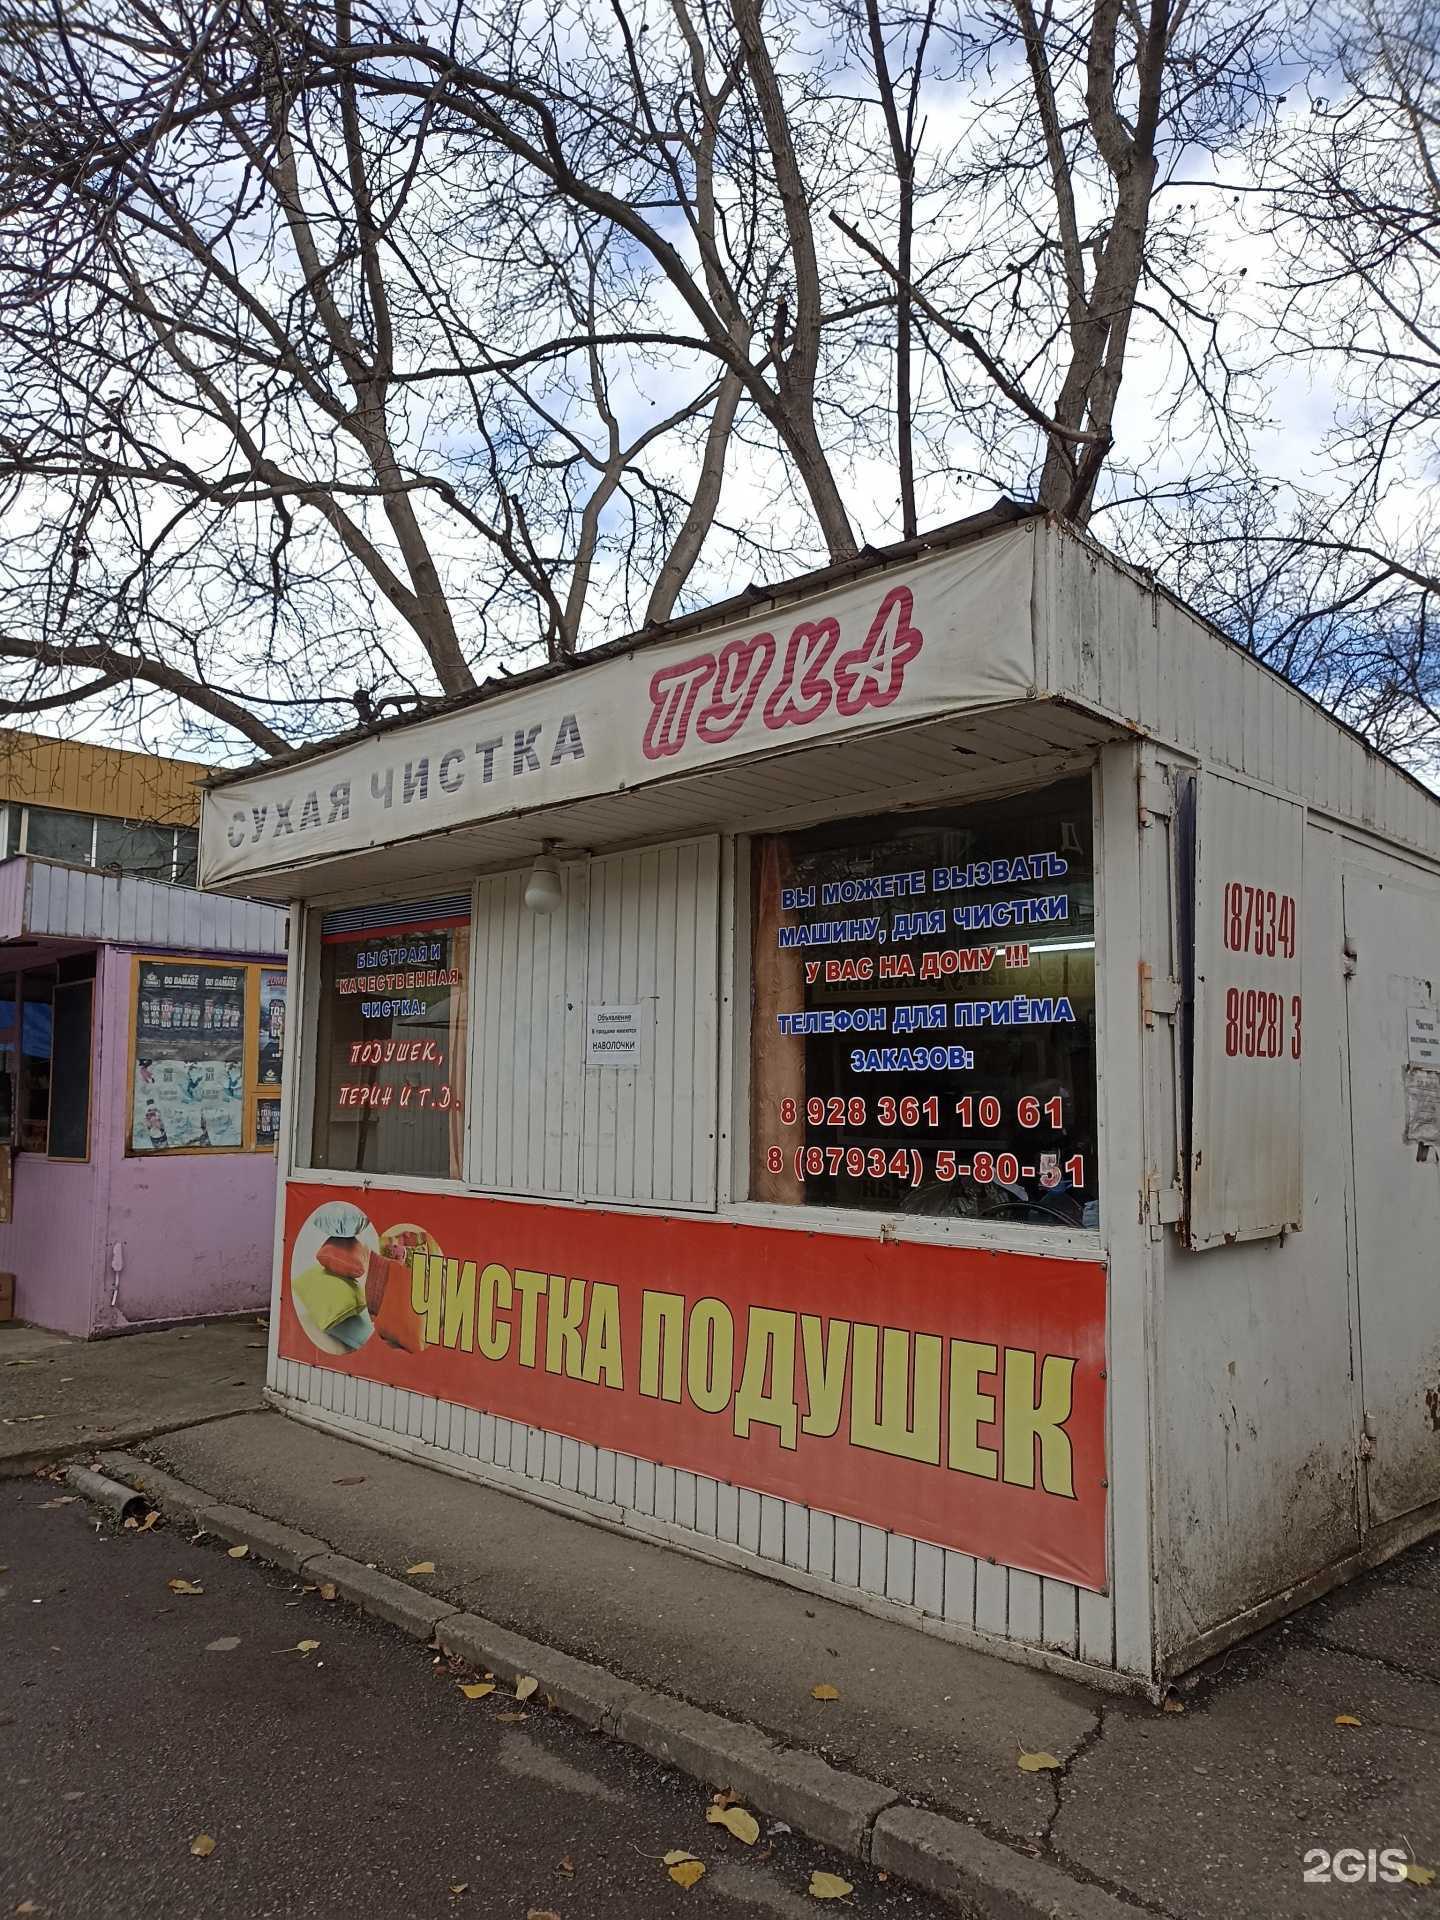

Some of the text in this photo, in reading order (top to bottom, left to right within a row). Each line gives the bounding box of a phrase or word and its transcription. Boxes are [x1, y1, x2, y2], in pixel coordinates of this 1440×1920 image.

[227, 712, 585, 849] СУХАЯ ЧИСТКА
[781, 852, 1068, 910] ВЫ МОЖЕТЕ ВЫЗВАТЬ
[778, 895, 1068, 948] МАШИНУ, ДЛЯ ЧИСТКИ
[1224, 882, 1296, 959] (87934)
[356, 944, 441, 968] БЫСТРАЯ И
[806, 961, 821, 984] У
[825, 957, 873, 981] ВАС
[879, 955, 915, 979] НА
[920, 945, 997, 980] ДОМУ
[339, 968, 459, 995] КАЧЕСТВЕННАЯ
[361, 999, 426, 1018] ЧИСТКА:
[777, 995, 1076, 1035] ТЕЛЕФОН ДЛЯ ПРИЁМА
[1225, 987, 1302, 1060] 8(928) 3
[350, 1042, 443, 1065] ПОДУШЕК,
[592, 1041, 636, 1051] НАВОЛОЧКИ
[850, 1047, 974, 1072] ЗАКАЗОВ:
[339, 1087, 393, 1105] ПЕРИН
[400, 1086, 411, 1107] И
[780, 1095, 1063, 1129] 8 928 361 10 61
[767, 1146, 1085, 1188] 8 (87934) 5-80-51
[410, 1253, 1080, 1500] ЧИСТКА ПОДУШЕК
